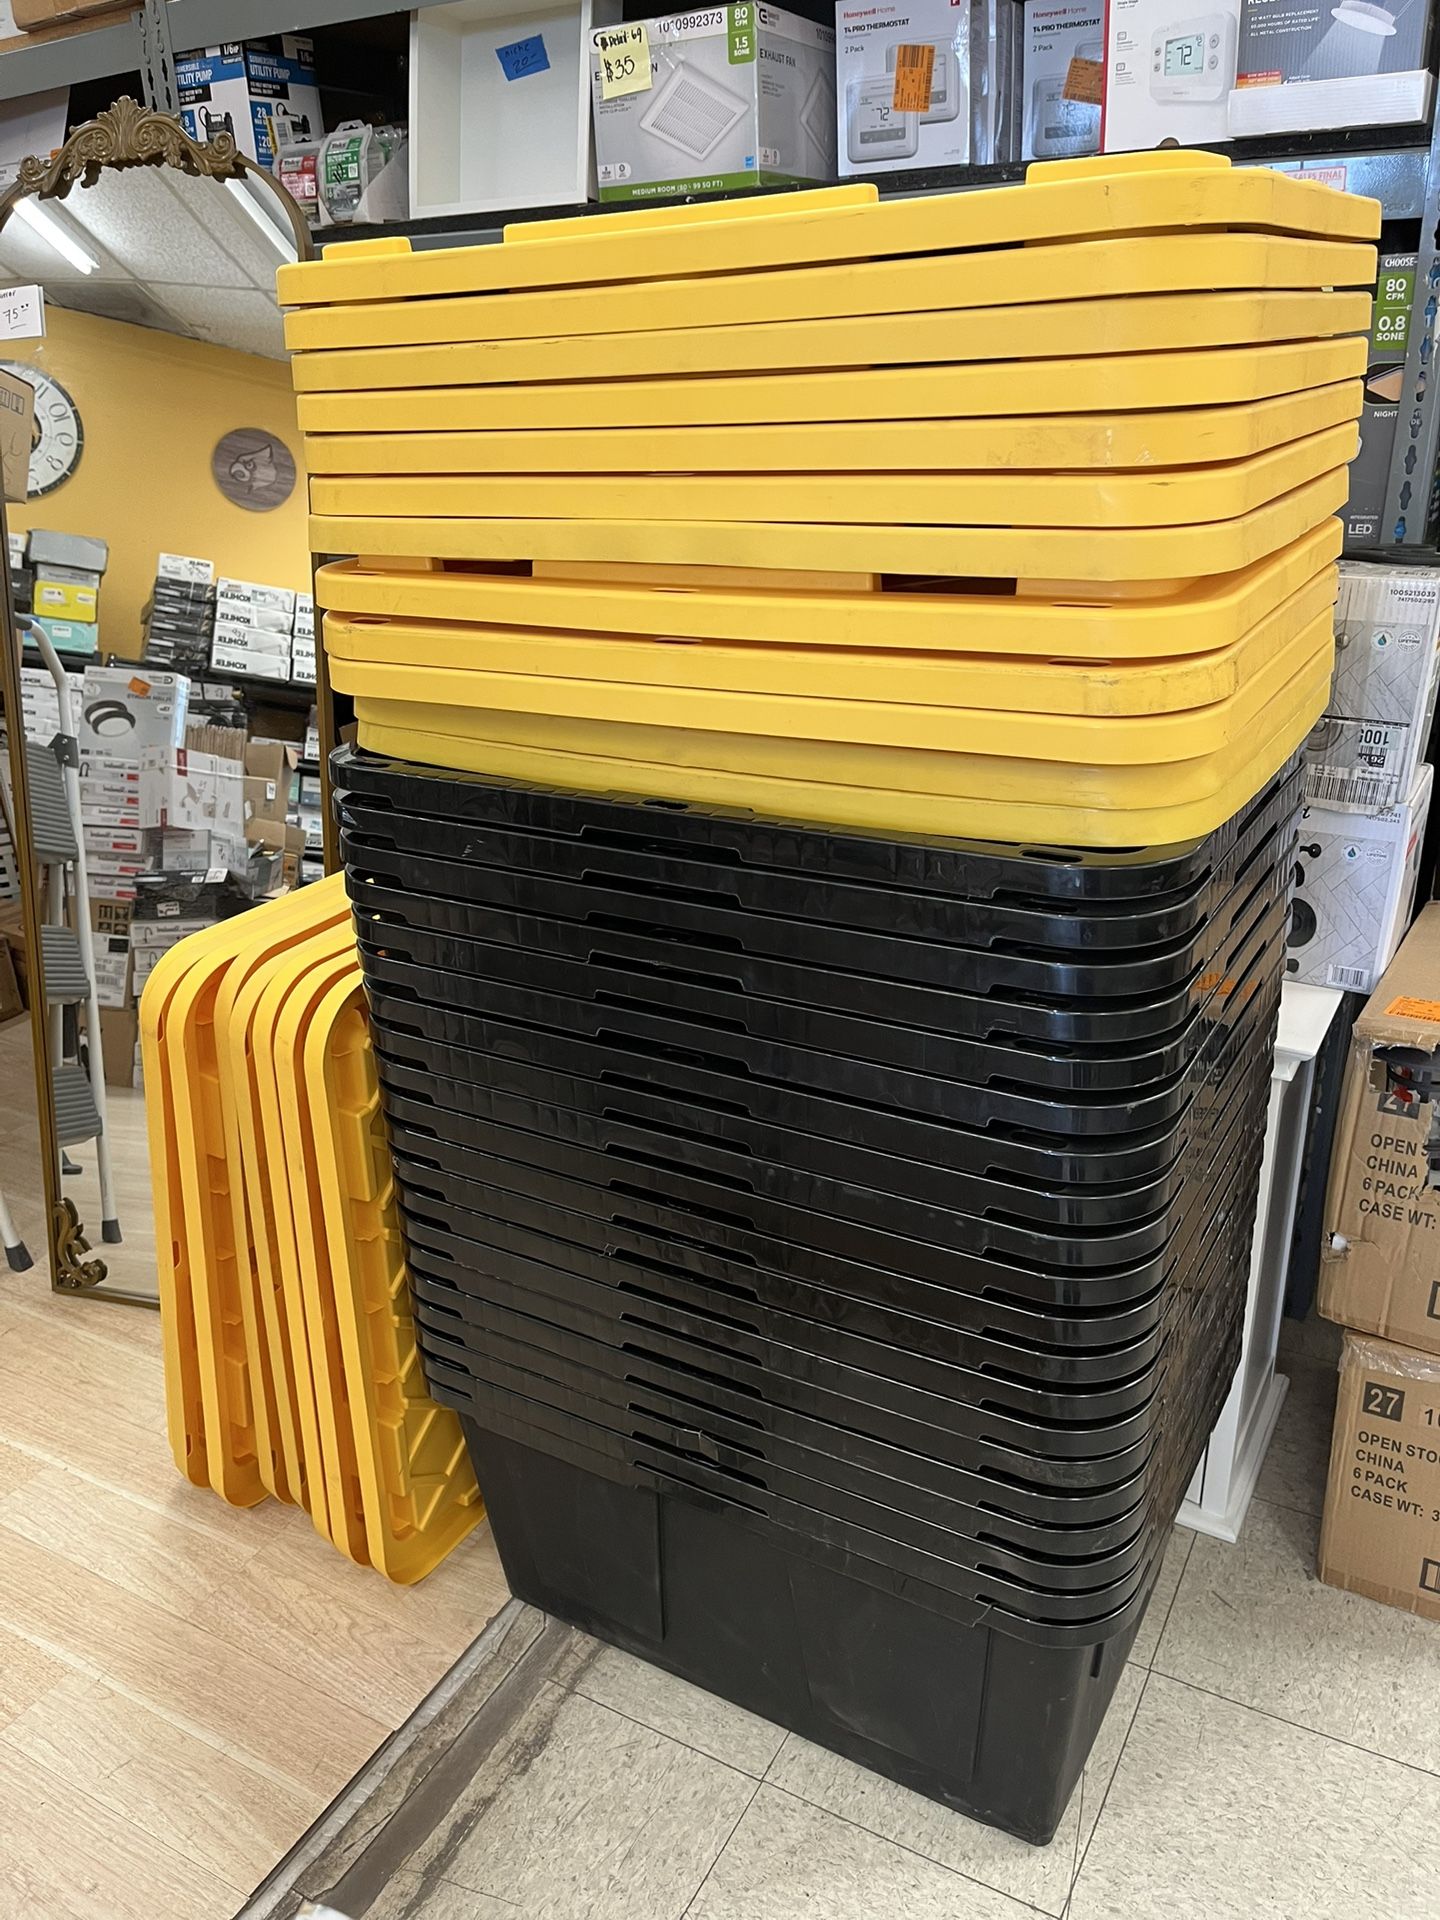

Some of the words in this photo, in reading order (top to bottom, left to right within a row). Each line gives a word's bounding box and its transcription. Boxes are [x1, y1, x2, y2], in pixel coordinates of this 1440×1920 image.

[734, 7, 748, 19] 80
[843, 8, 877, 20] Honeywell
[877, 6, 896, 14] Home
[1033, 8, 1067, 19] Honeywell
[1068, 6, 1087, 14] Home
[1286, 9, 1319, 17] REPLACEMENT
[735, 19, 748, 27] CFM
[844, 26, 852, 34] T4
[852, 24, 866, 32] PRO
[866, 18, 910, 30] THERMOSTAT
[1041, 24, 1055, 32] PRO
[1056, 18, 1101, 30] THERMOSTAT
[1276, 26, 1312, 34] CONSTRUCTION
[735, 37, 748, 49] 1.5
[850, 45, 865, 53] Pack
[734, 48, 750, 56] SONE
[759, 48, 785, 65] EXHAUST
[785, 56, 796, 68] FAN
[1176, 45, 1192, 66] 72
[249, 65, 273, 79] UTILITY
[273, 68, 291, 80] PUMP
[603, 55, 635, 83] $35
[177, 72, 195, 87] TILITY
[195, 69, 213, 84] PUMP
[876, 106, 889, 122] 72
[1319, 170, 1343, 180] FINAL
[632, 187, 657, 196] MEDIUM
[657, 185, 676, 194] ROOM
[1386, 278, 1407, 292] 80
[1385, 292, 1405, 300] CFM
[1378, 315, 1406, 331] 0.8
[1376, 332, 1405, 341] SONE
[1373, 410, 1399, 418] NIGHT
[1348, 523, 1373, 535] LED
[1390, 589, 1436, 598] 1005213039
[1371, 1134, 1417, 1156] OPEN
[1367, 1155, 1418, 1178] CHINA
[1362, 1177, 1372, 1191] 6
[1375, 1180, 1420, 1201] PACK
[1359, 1199, 1404, 1222] CASE
[1408, 1209, 1437, 1230] WT:
[1368, 1388, 1400, 1415] 27
[1358, 1431, 1402, 1453] OPEN
[1406, 1444, 1440, 1464] STO
[1356, 1449, 1405, 1474] CHINA
[1353, 1467, 1361, 1479] 6
[1365, 1470, 1408, 1494] PACK
[1351, 1485, 1393, 1508] CASE
[1397, 1498, 1424, 1517] WT:
